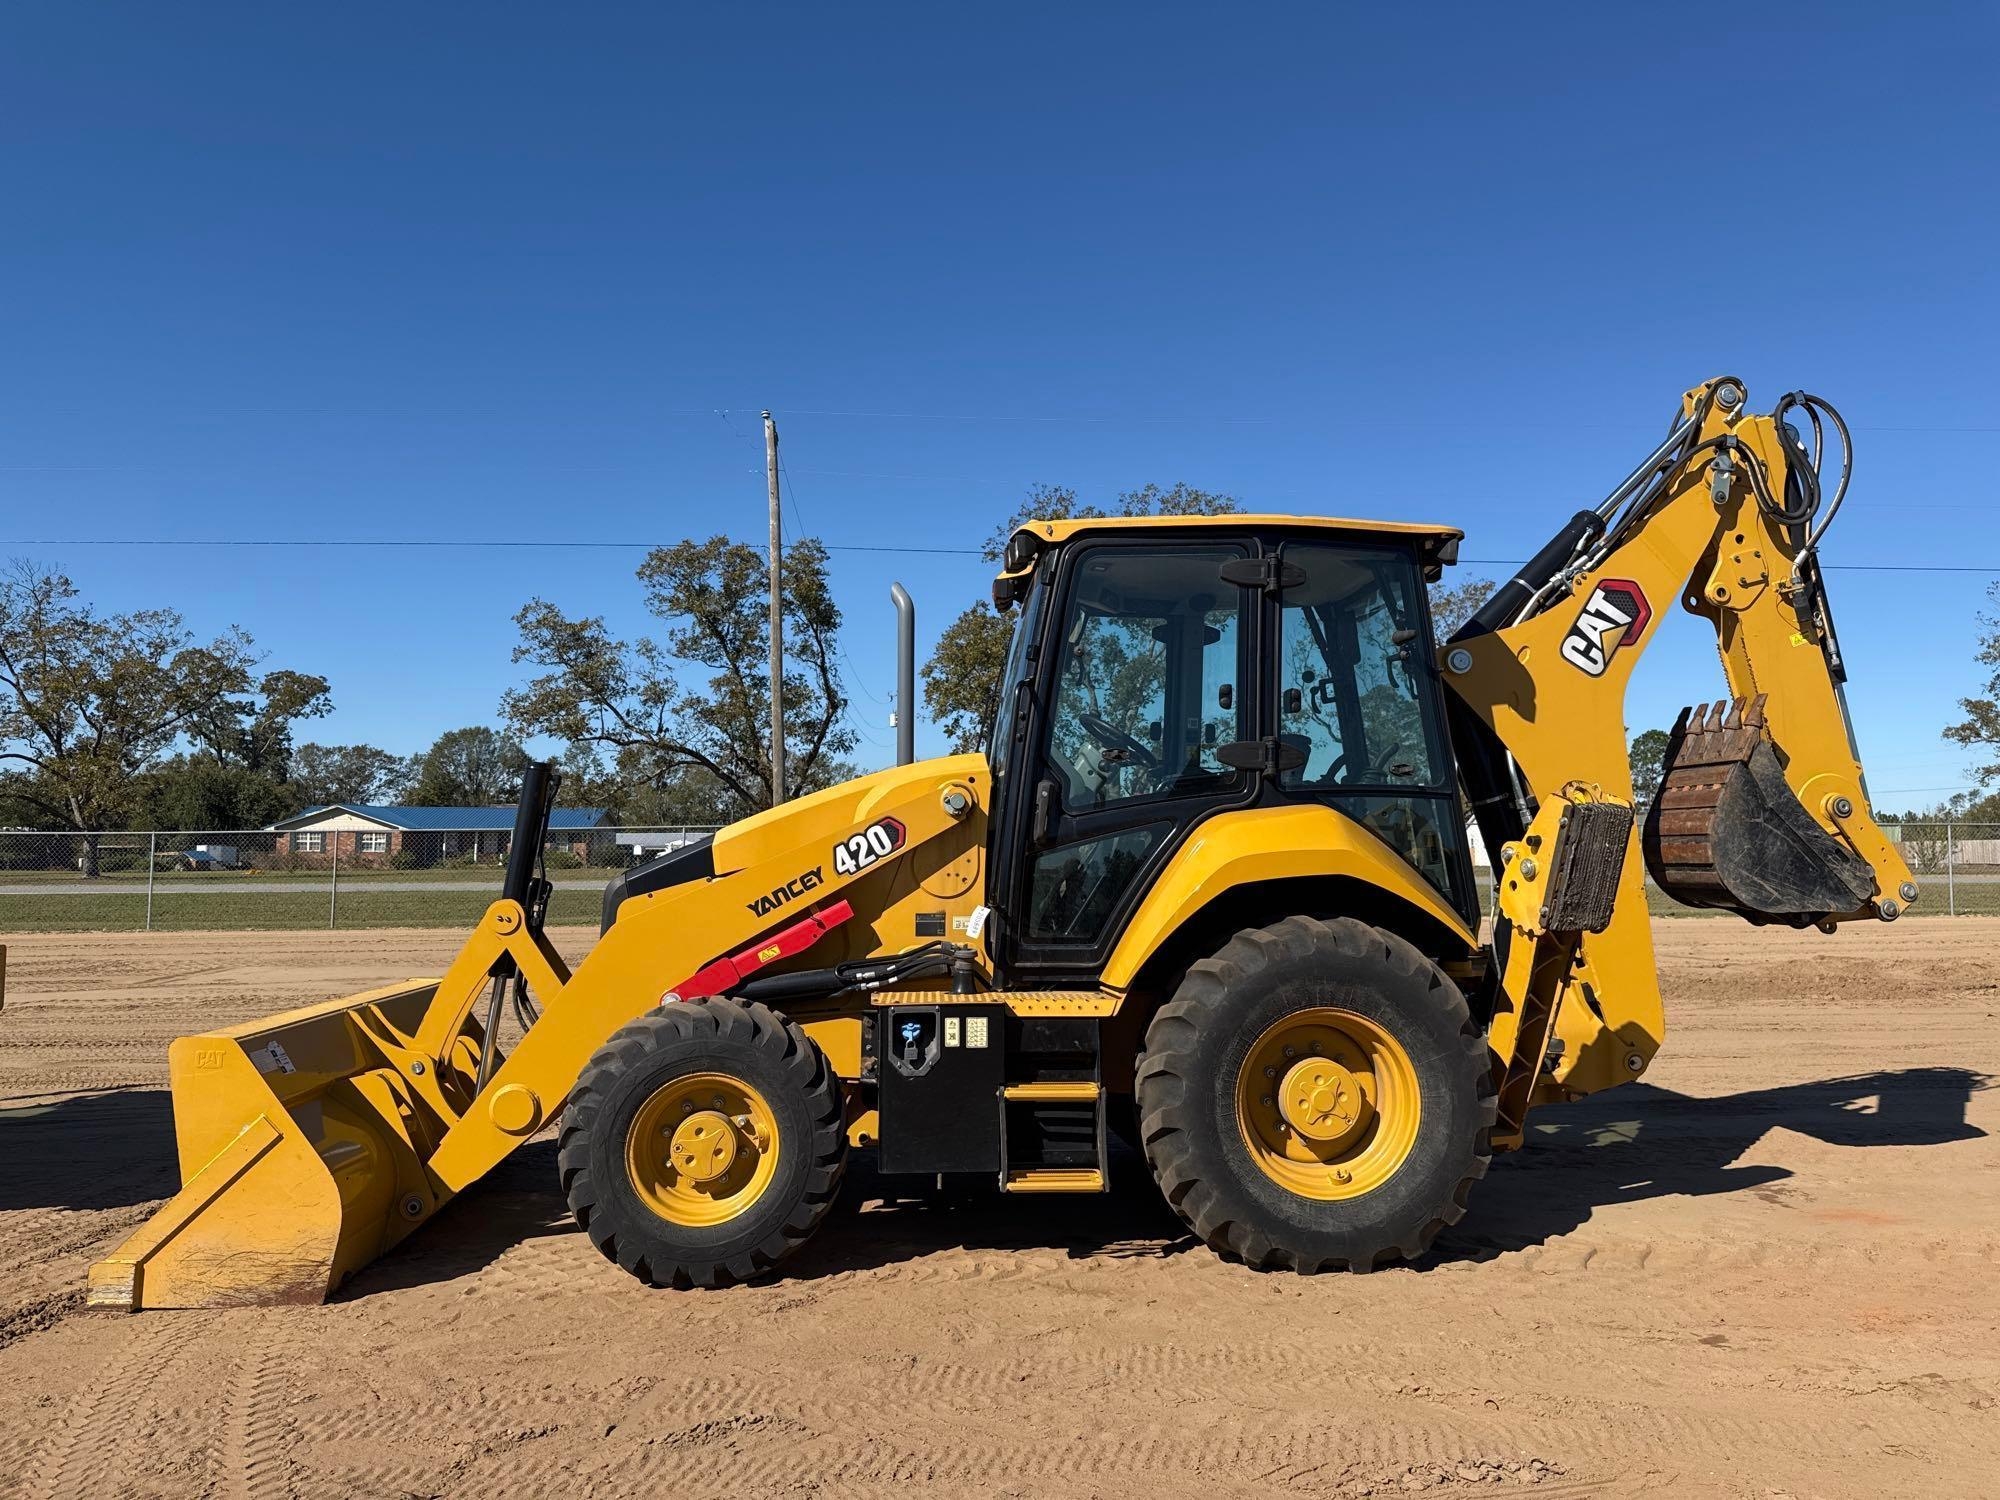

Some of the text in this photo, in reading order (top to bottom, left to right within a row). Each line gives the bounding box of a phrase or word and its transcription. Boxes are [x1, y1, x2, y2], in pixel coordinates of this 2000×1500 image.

[1562, 588, 1632, 675] CAT
[835, 825, 892, 874] 420
[746, 866, 824, 917] YANCEY
[195, 1050, 227, 1070] CAT
